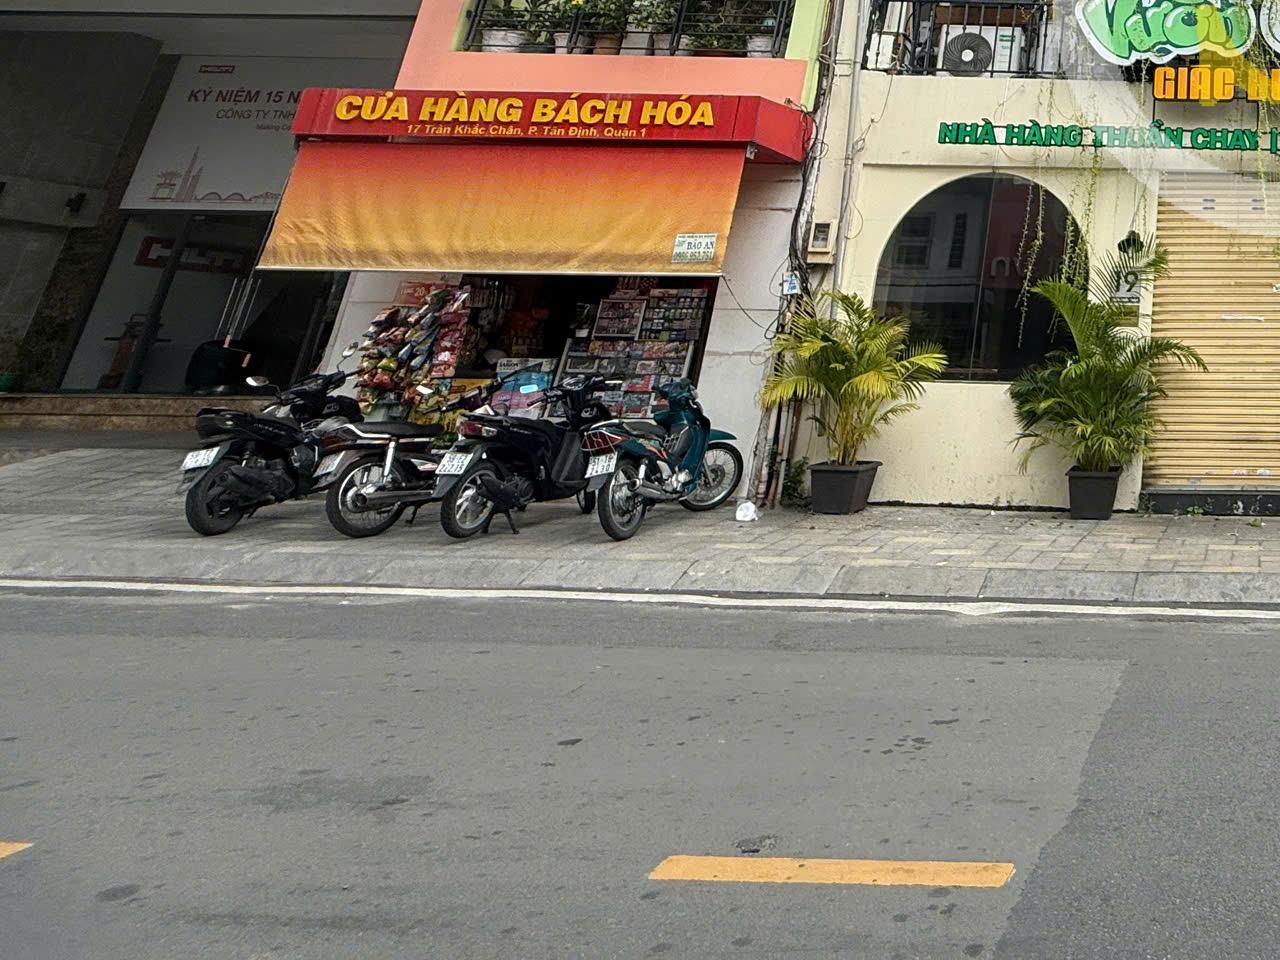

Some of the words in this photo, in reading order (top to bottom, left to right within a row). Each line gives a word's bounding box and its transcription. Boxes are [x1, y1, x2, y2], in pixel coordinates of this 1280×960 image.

[215, 87, 260, 105] NIỆM
[265, 90, 283, 103] 15
[216, 107, 252, 119] CÔNG
[256, 109, 271, 119] TY
[419, 90, 524, 122] HÀNG
[531, 92, 632, 124] BÁCH
[639, 95, 715, 126] HÓA
[407, 125, 420, 134] 17
[527, 127, 538, 136] P.
[604, 127, 637, 139] Quận
[640, 128, 647, 137] 1
[938, 118, 997, 144] NHÀ
[1005, 119, 1083, 147] HÀNG
[1190, 128, 1259, 151] CHAY
